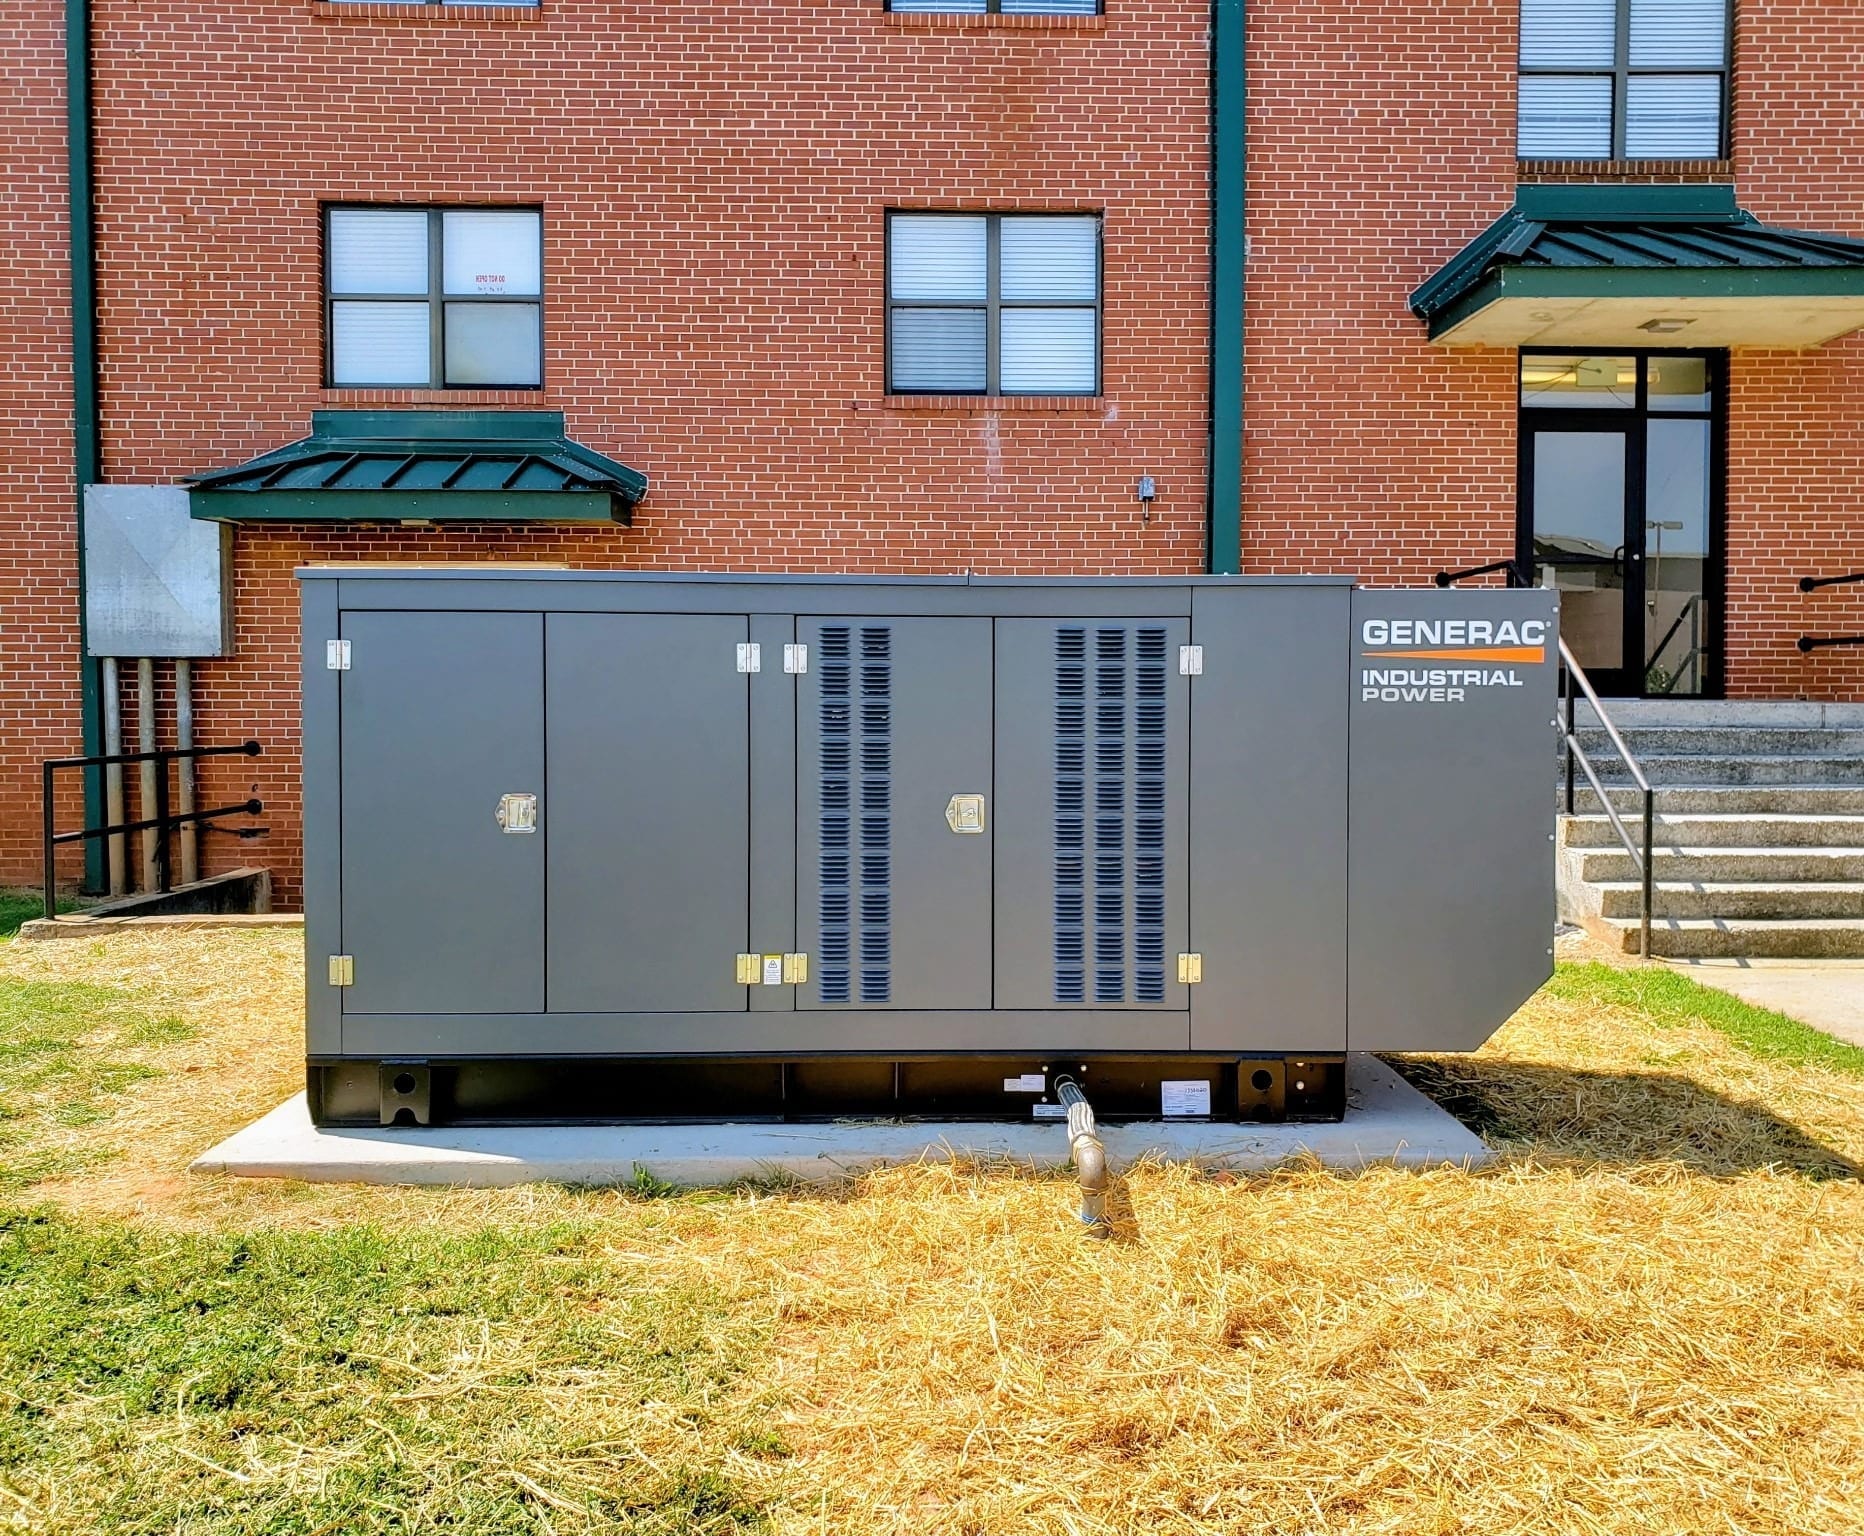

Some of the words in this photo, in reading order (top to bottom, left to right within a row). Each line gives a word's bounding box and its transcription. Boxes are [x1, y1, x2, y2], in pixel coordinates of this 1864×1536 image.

[1362, 619, 1546, 646] GENERAC
[1362, 669, 1524, 686] INDUSTRIAL
[1362, 687, 1465, 702] POWER
